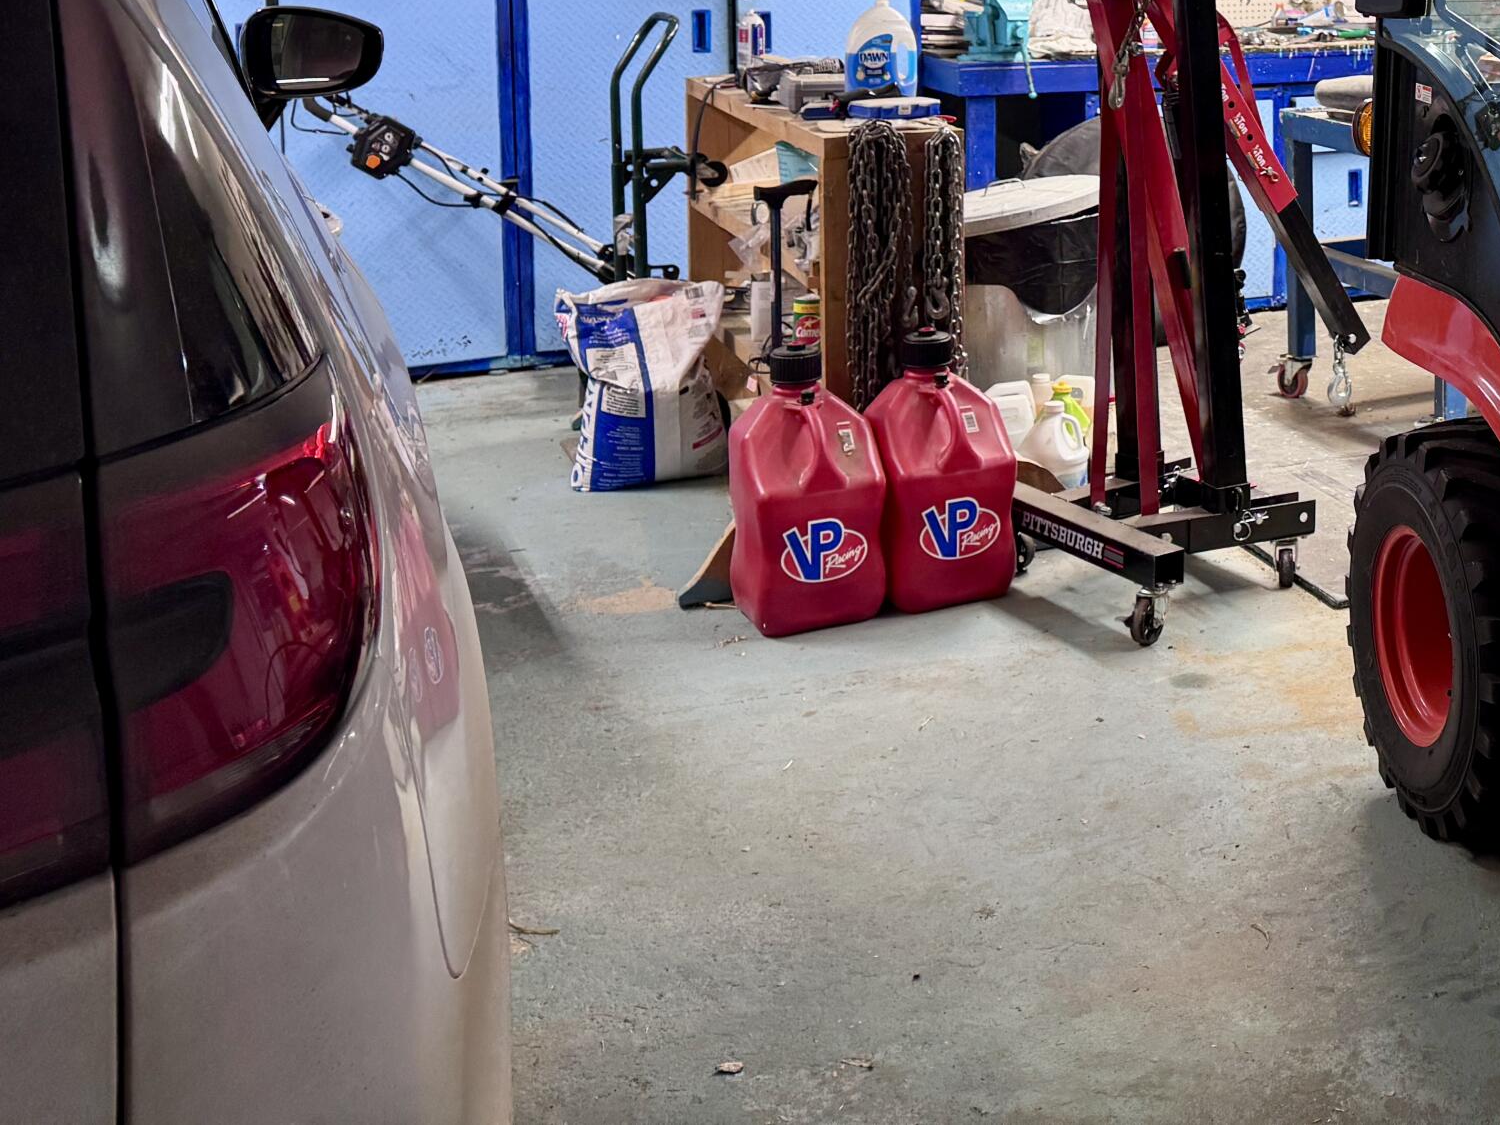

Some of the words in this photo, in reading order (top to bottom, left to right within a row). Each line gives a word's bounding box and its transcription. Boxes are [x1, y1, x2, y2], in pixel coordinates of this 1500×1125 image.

[858, 51, 890, 63] DAWN
[783, 518, 844, 581] VP
[825, 543, 865, 574] Racing
[921, 497, 979, 559] VP
[961, 521, 999, 551] Racing
[1022, 511, 1104, 560] PITTSBURGH
